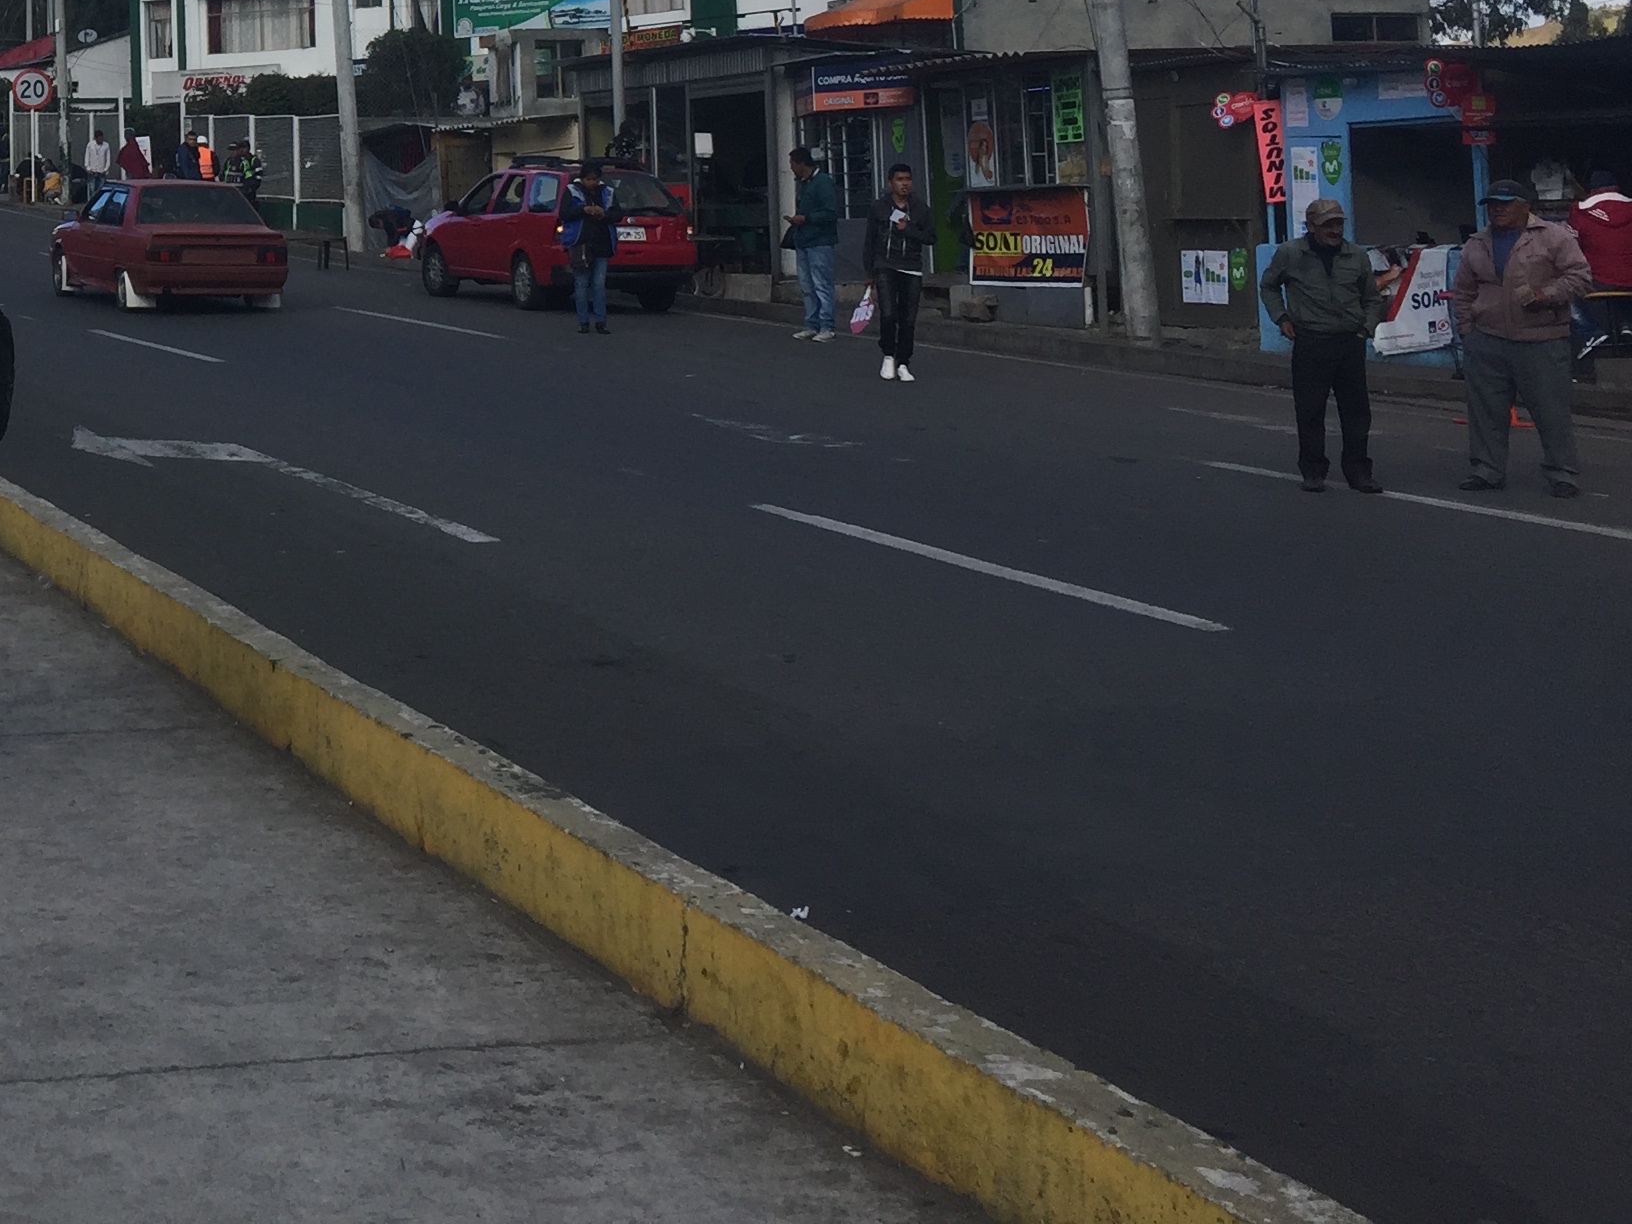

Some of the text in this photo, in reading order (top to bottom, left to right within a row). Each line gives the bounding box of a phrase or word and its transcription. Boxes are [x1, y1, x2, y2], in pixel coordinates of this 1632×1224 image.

[20, 79, 45, 99] 20
[817, 75, 852, 85] COMPRA
[975, 231, 1086, 255] SOAT ORIGINAL
[1033, 258, 1054, 277] 24
